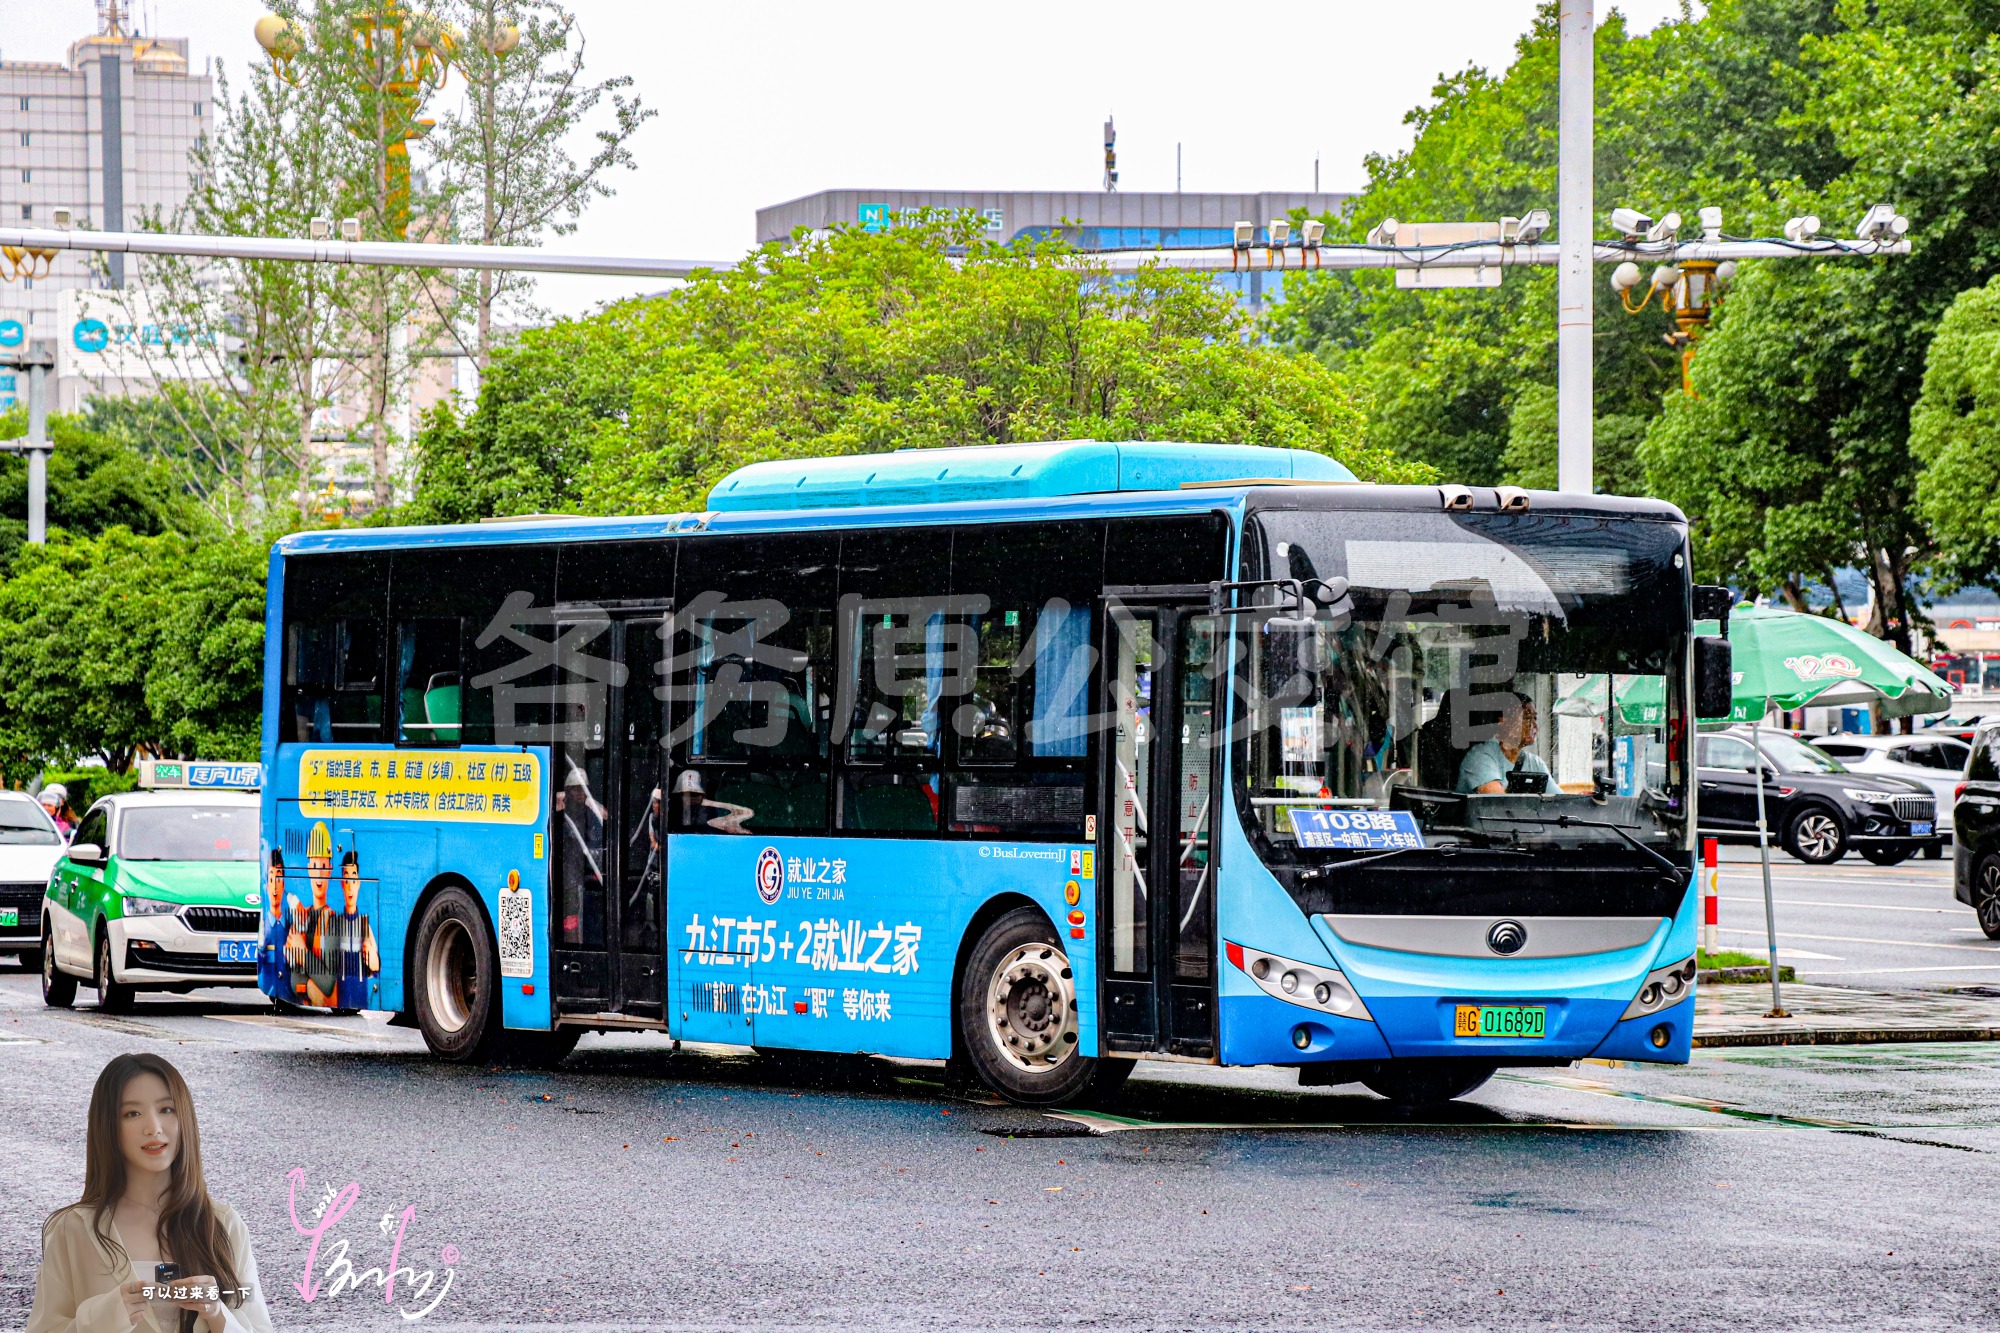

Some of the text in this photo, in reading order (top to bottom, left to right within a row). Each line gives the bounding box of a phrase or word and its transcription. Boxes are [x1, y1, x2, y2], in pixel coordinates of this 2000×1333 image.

[155, 764, 182, 778] 空车
[190, 767, 259, 786] 匡庐山泉
[1312, 813, 1397, 831] 108路
[787, 857, 847, 885] 就业之家
[787, 887, 845, 901] JIU YE ZHI JIA
[684, 913, 922, 976] 九江市5+2就业之家
